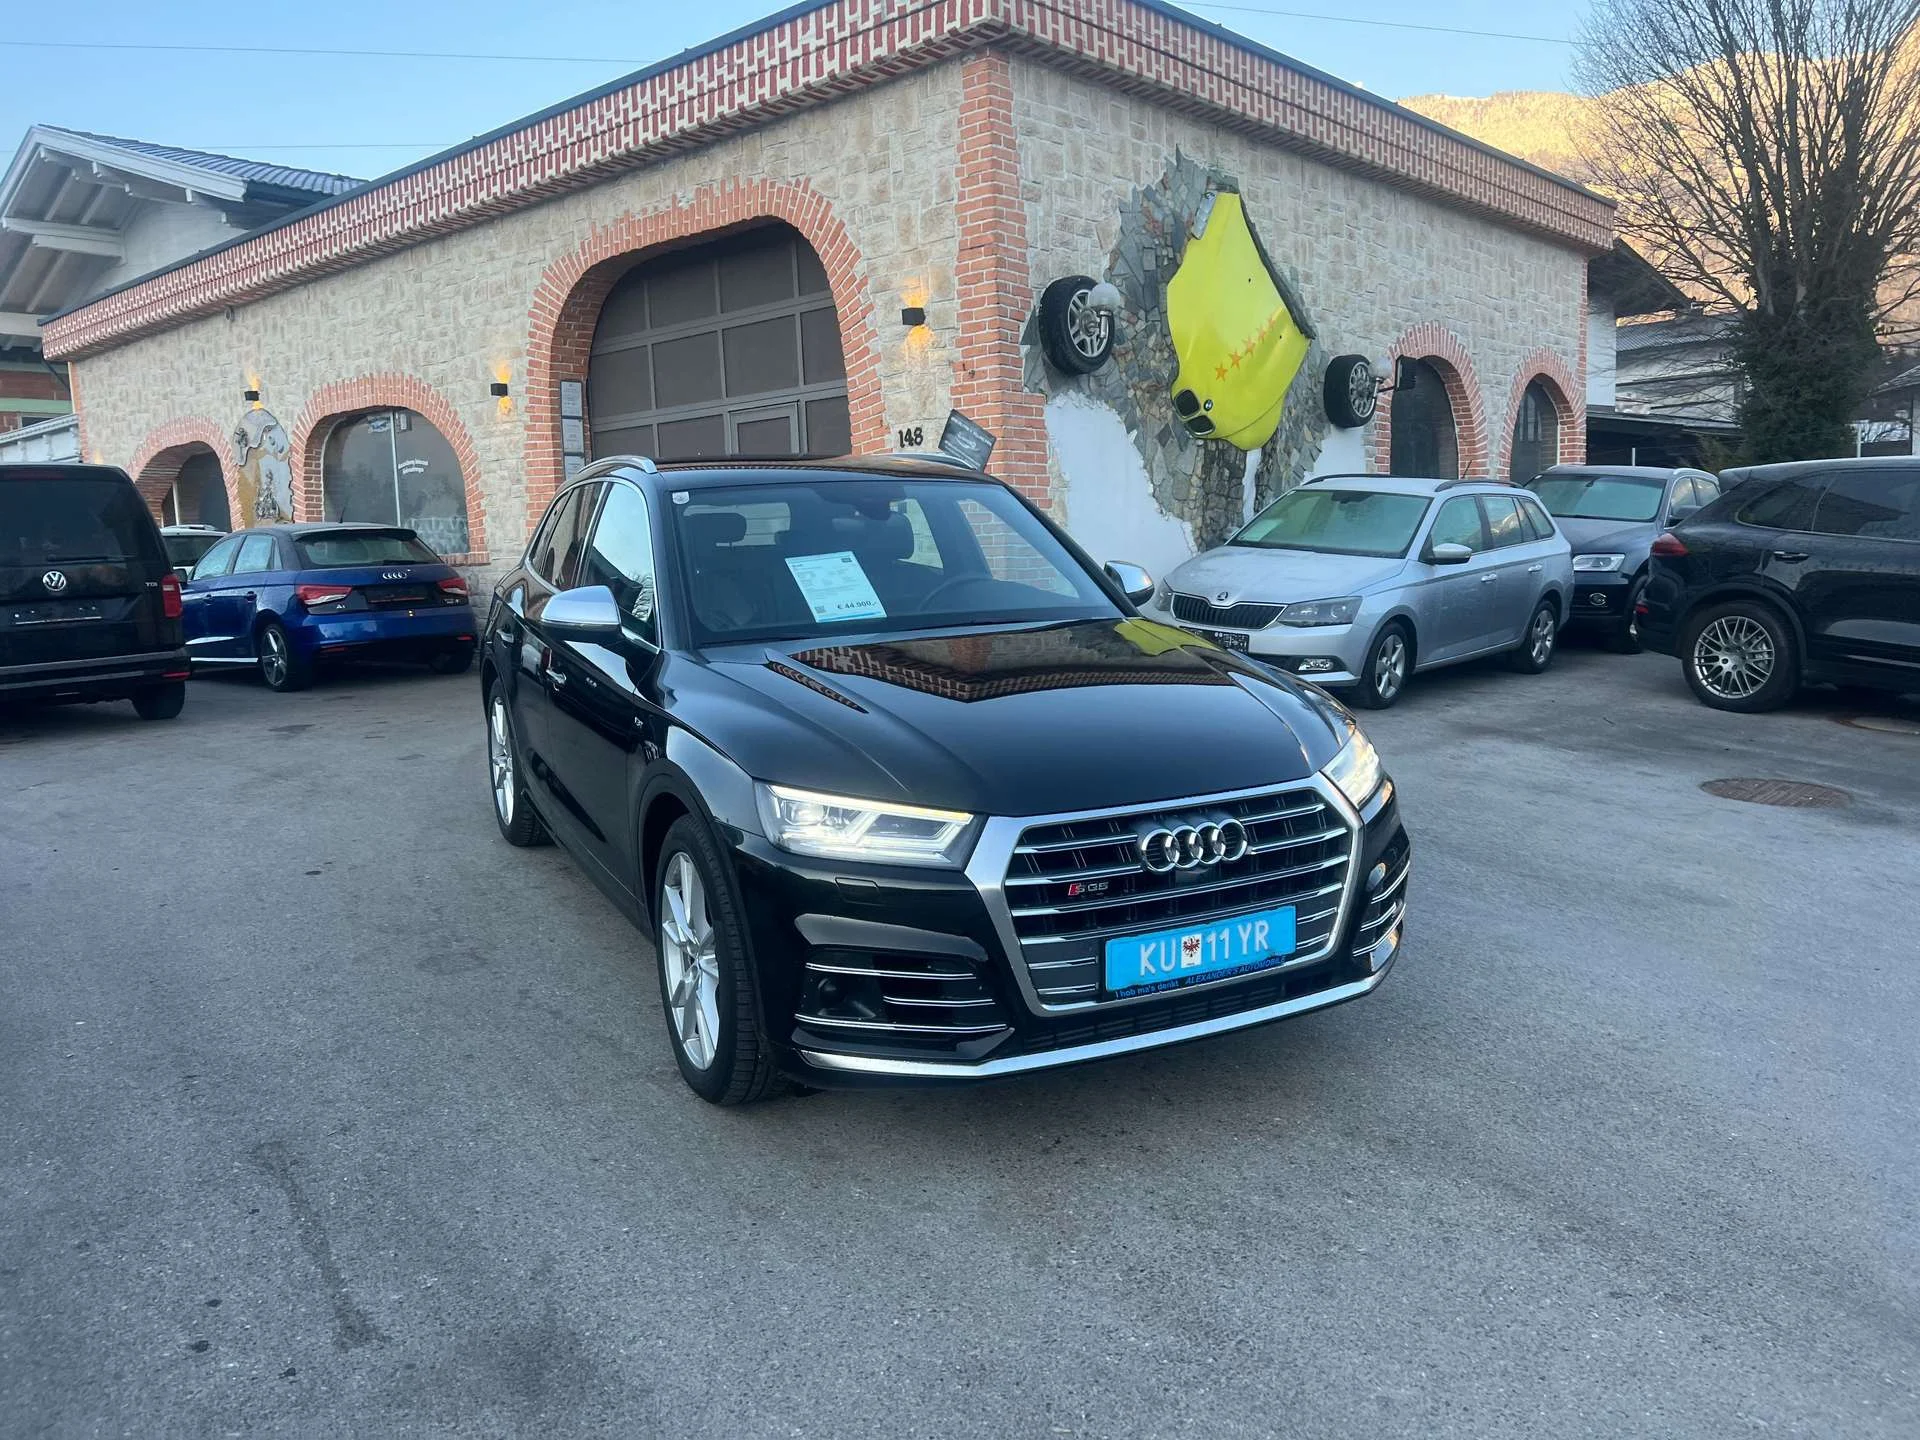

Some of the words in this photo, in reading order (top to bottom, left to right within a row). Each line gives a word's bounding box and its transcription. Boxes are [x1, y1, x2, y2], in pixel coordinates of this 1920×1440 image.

[898, 427, 923, 448] 148
[1139, 940, 1176, 976] KU
[1206, 928, 1229, 962] 11
[1238, 919, 1269, 955] YR
[1119, 989, 1136, 998] hob
